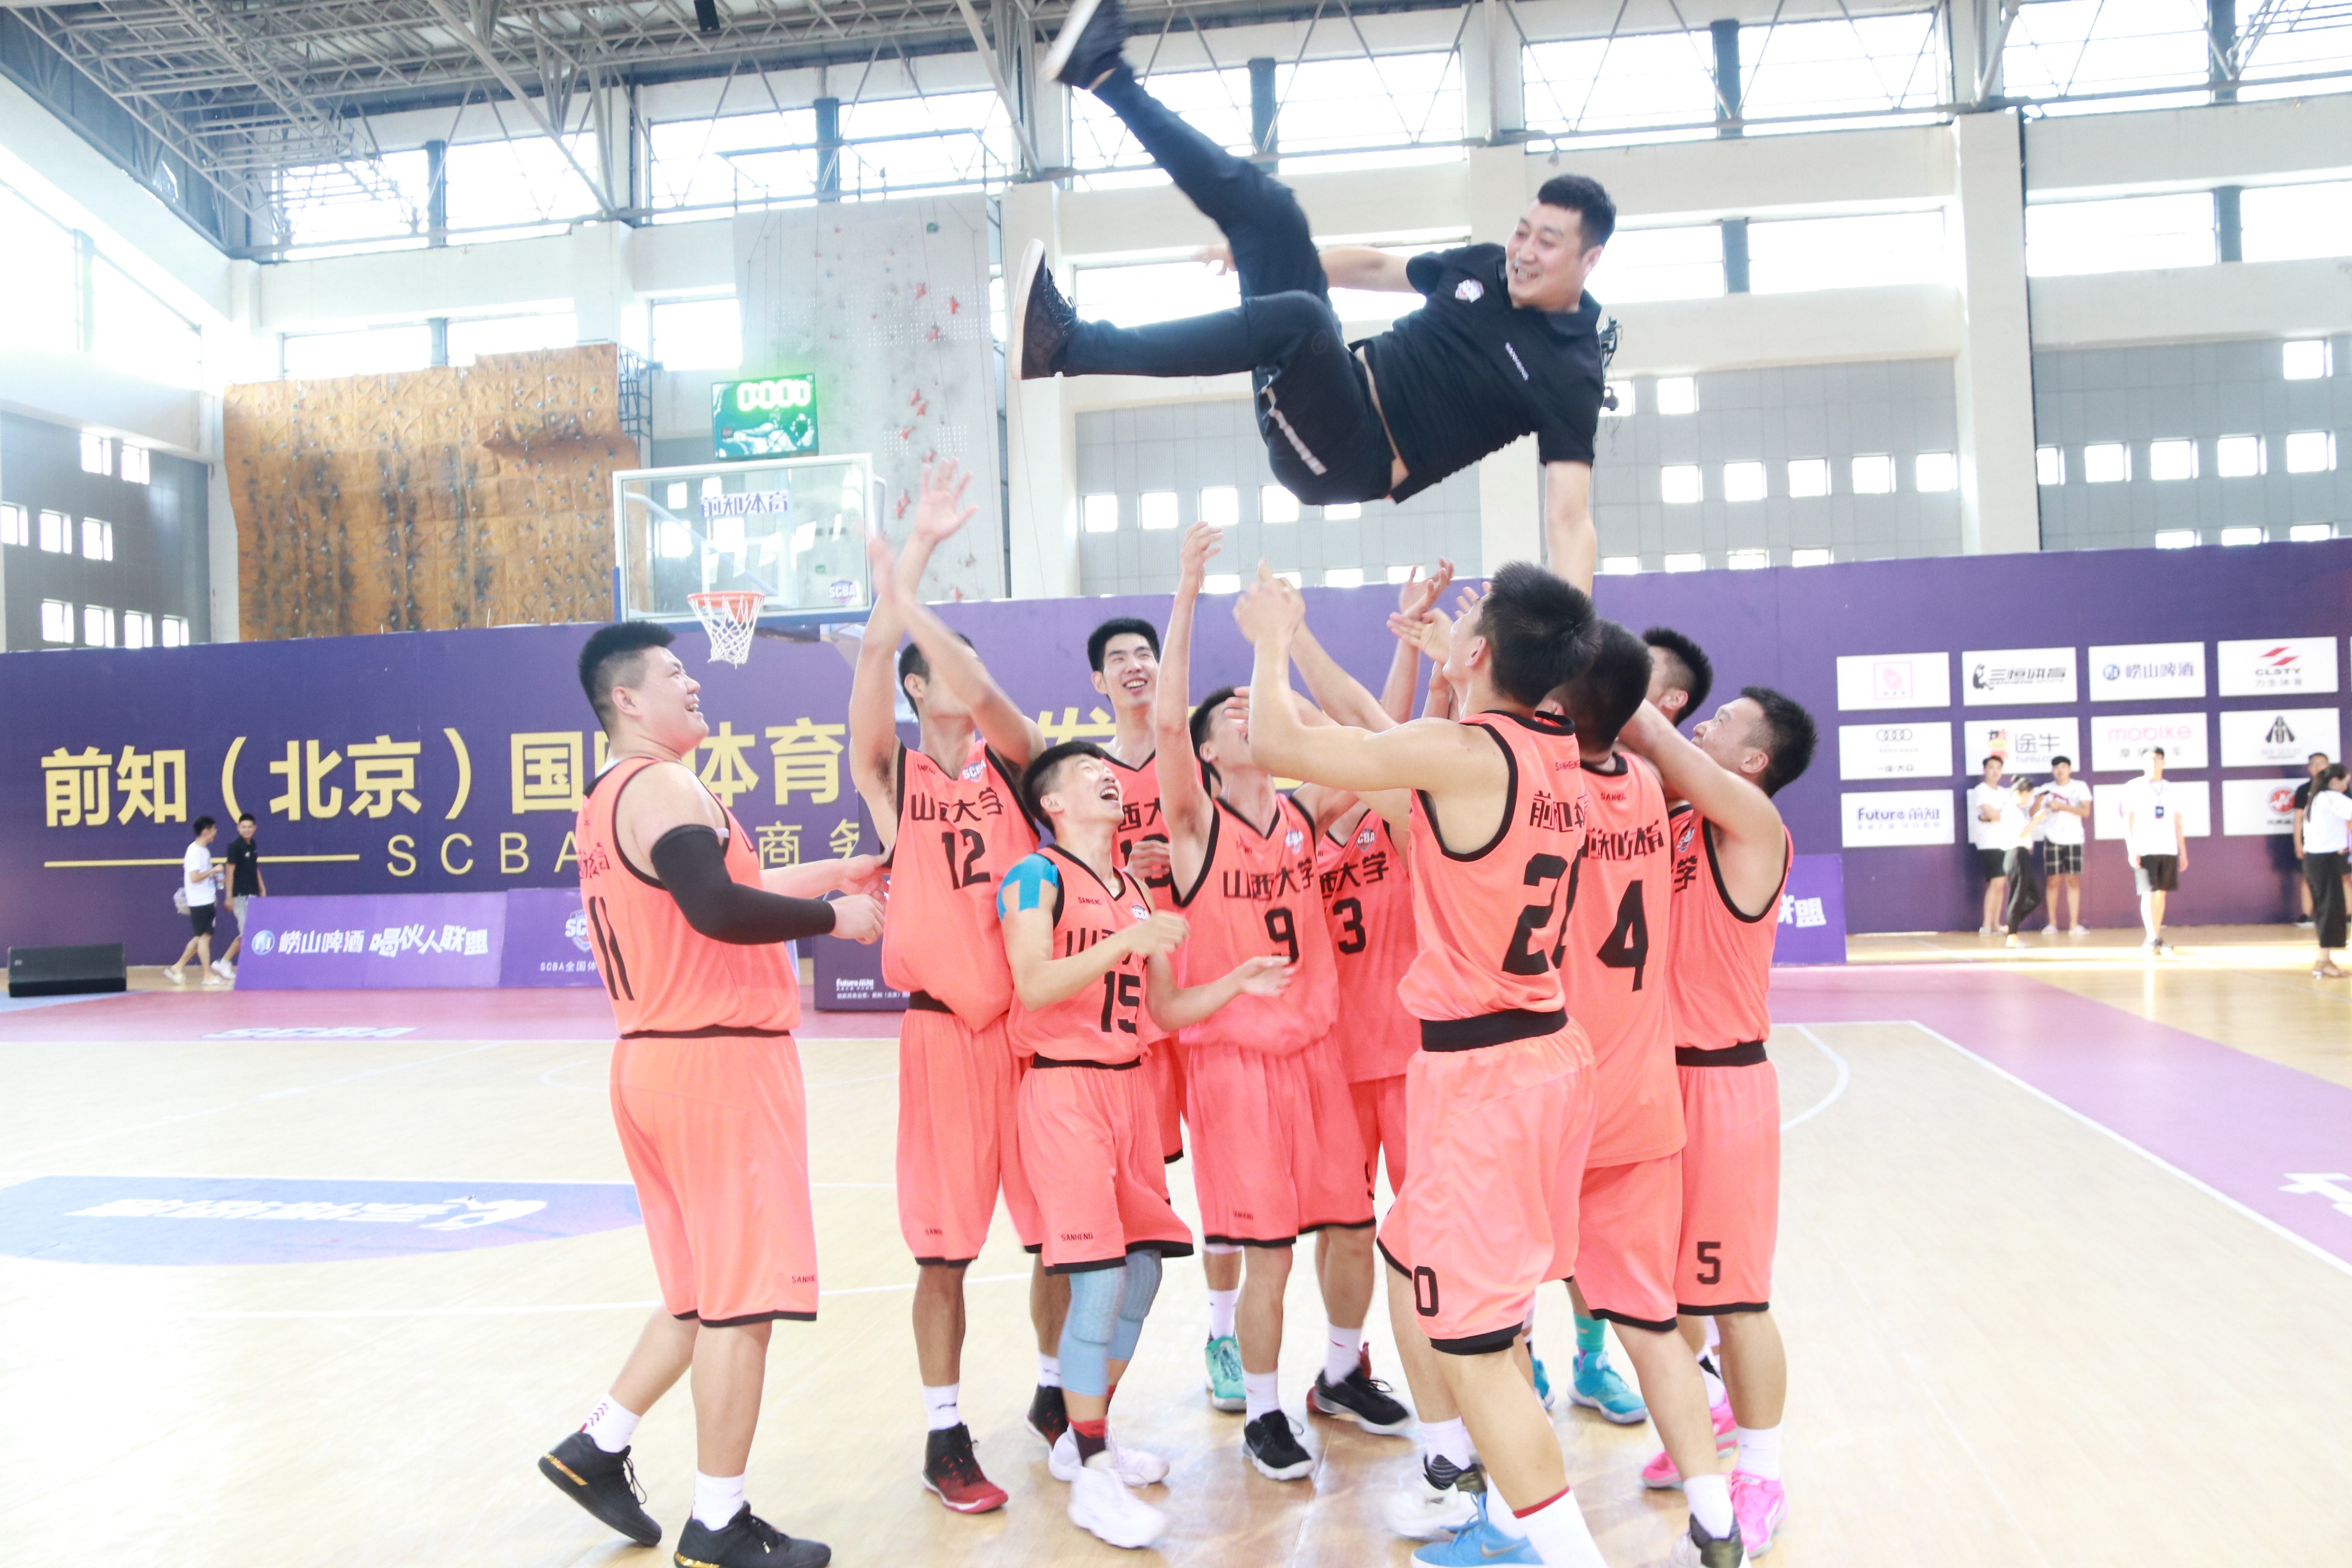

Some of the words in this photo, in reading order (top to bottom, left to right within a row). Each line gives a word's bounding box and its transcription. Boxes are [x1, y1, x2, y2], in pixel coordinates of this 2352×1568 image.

[828, 585, 856, 599] SCBA
[2125, 662, 2195, 680] 崂山啤酒
[2108, 725, 2192, 742] mobike
[1857, 808, 1905, 821] Future
[942, 828, 991, 890] 12
[1223, 856, 1314, 901] 山西大学
[1077, 896, 1102, 906] SANHENG
[278, 929, 365, 955] 崂山啤酒
[588, 896, 635, 1001] 11
[1264, 907, 1299, 965] 9
[1332, 897, 1366, 955] 3
[1596, 879, 1649, 992] 4
[1100, 971, 1141, 1036] 15
[1697, 1241, 1721, 1285] 5
[1414, 1265, 1439, 1317] 0
